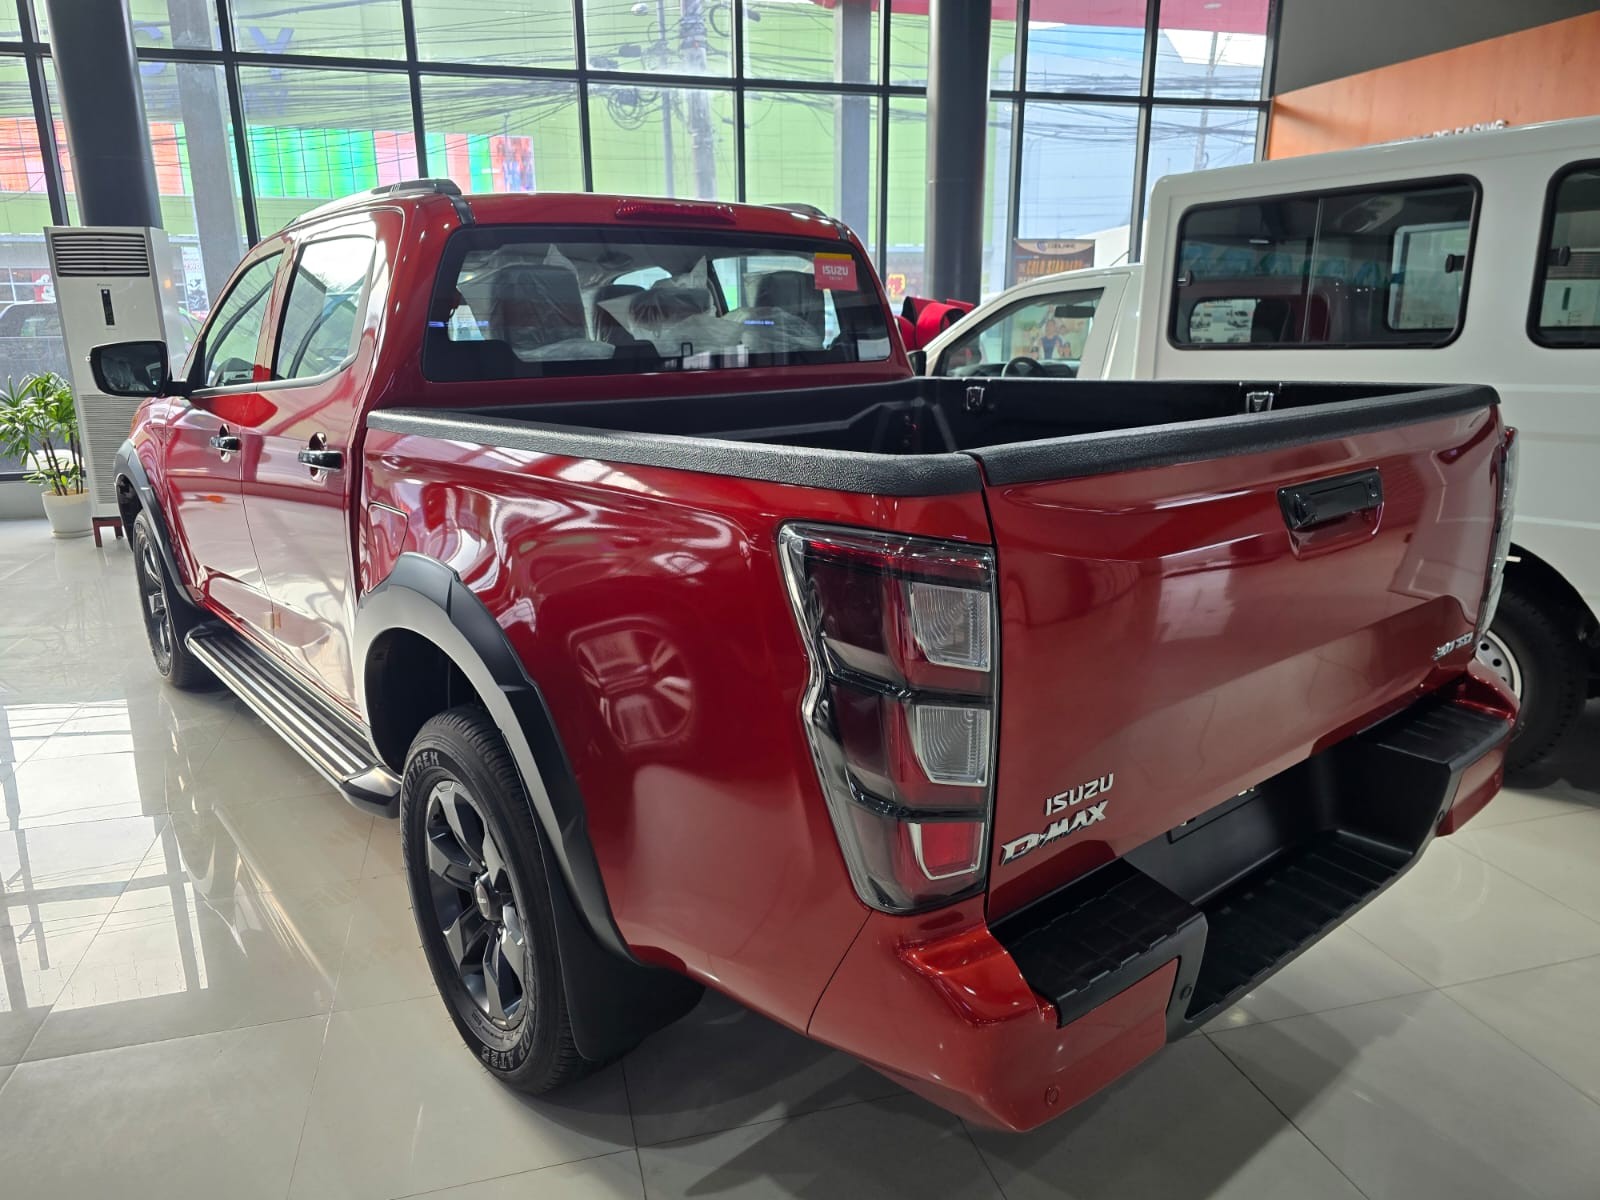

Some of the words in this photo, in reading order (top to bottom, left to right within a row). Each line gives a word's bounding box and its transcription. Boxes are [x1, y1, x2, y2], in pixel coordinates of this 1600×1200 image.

[822, 264, 849, 276] ISUZU
[1045, 773, 1114, 817] ISUZU
[1001, 800, 1109, 866] D-MAX
